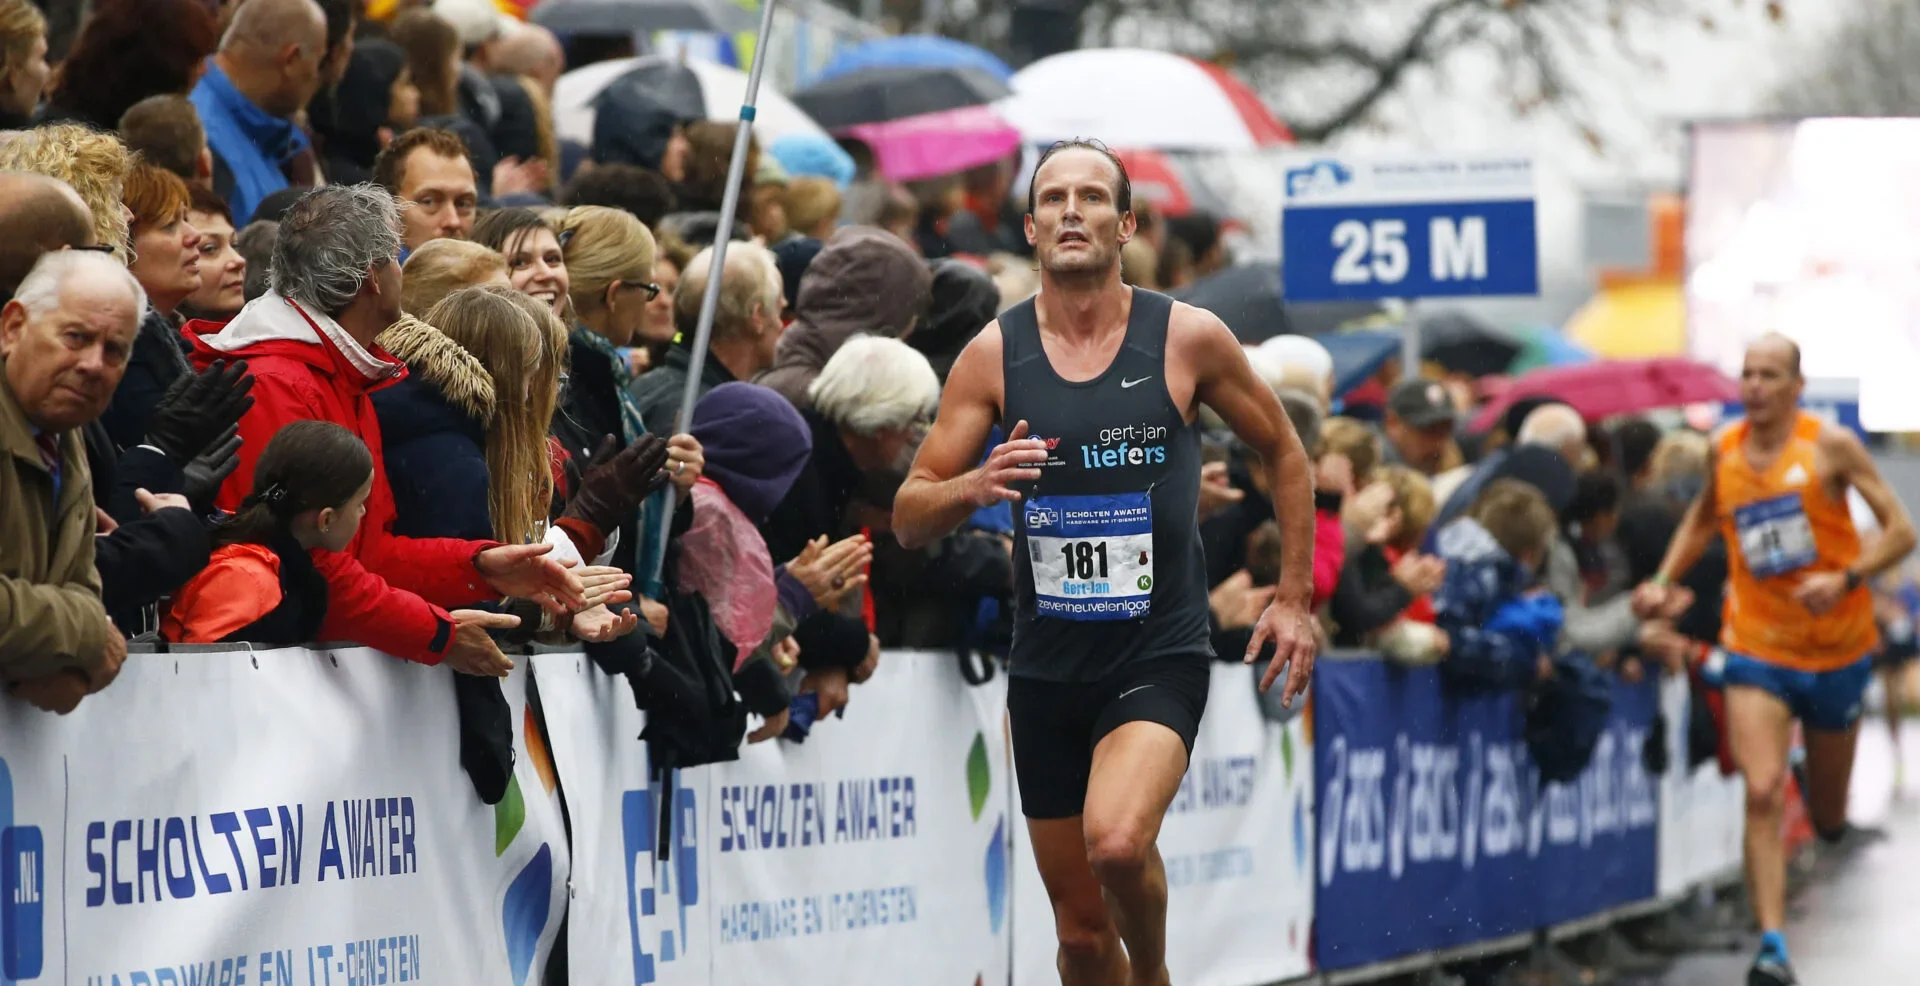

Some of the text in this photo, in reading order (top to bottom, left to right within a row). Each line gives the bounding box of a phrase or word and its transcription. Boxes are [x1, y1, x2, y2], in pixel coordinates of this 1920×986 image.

[1330, 215, 1488, 285] 25 M
[1100, 422, 1167, 446] gert-jan
[1081, 442, 1166, 469] liefers
[1066, 511, 1111, 519] SCHOLTEN
[1113, 507, 1148, 516] AWATER
[1061, 541, 1109, 580] 181
[1063, 581, 1110, 595] Gert-Jan
[1140, 577, 1149, 587] K
[1038, 599, 1151, 613] zevenheuvelenloop
[720, 776, 917, 852] SCHOLTEN AWATER
[86, 796, 417, 908] SCHOLTEN AWATER
[14, 851, 40, 904] .NL
[720, 883, 918, 944] HARDWARE EN IT-DIENSTEN
